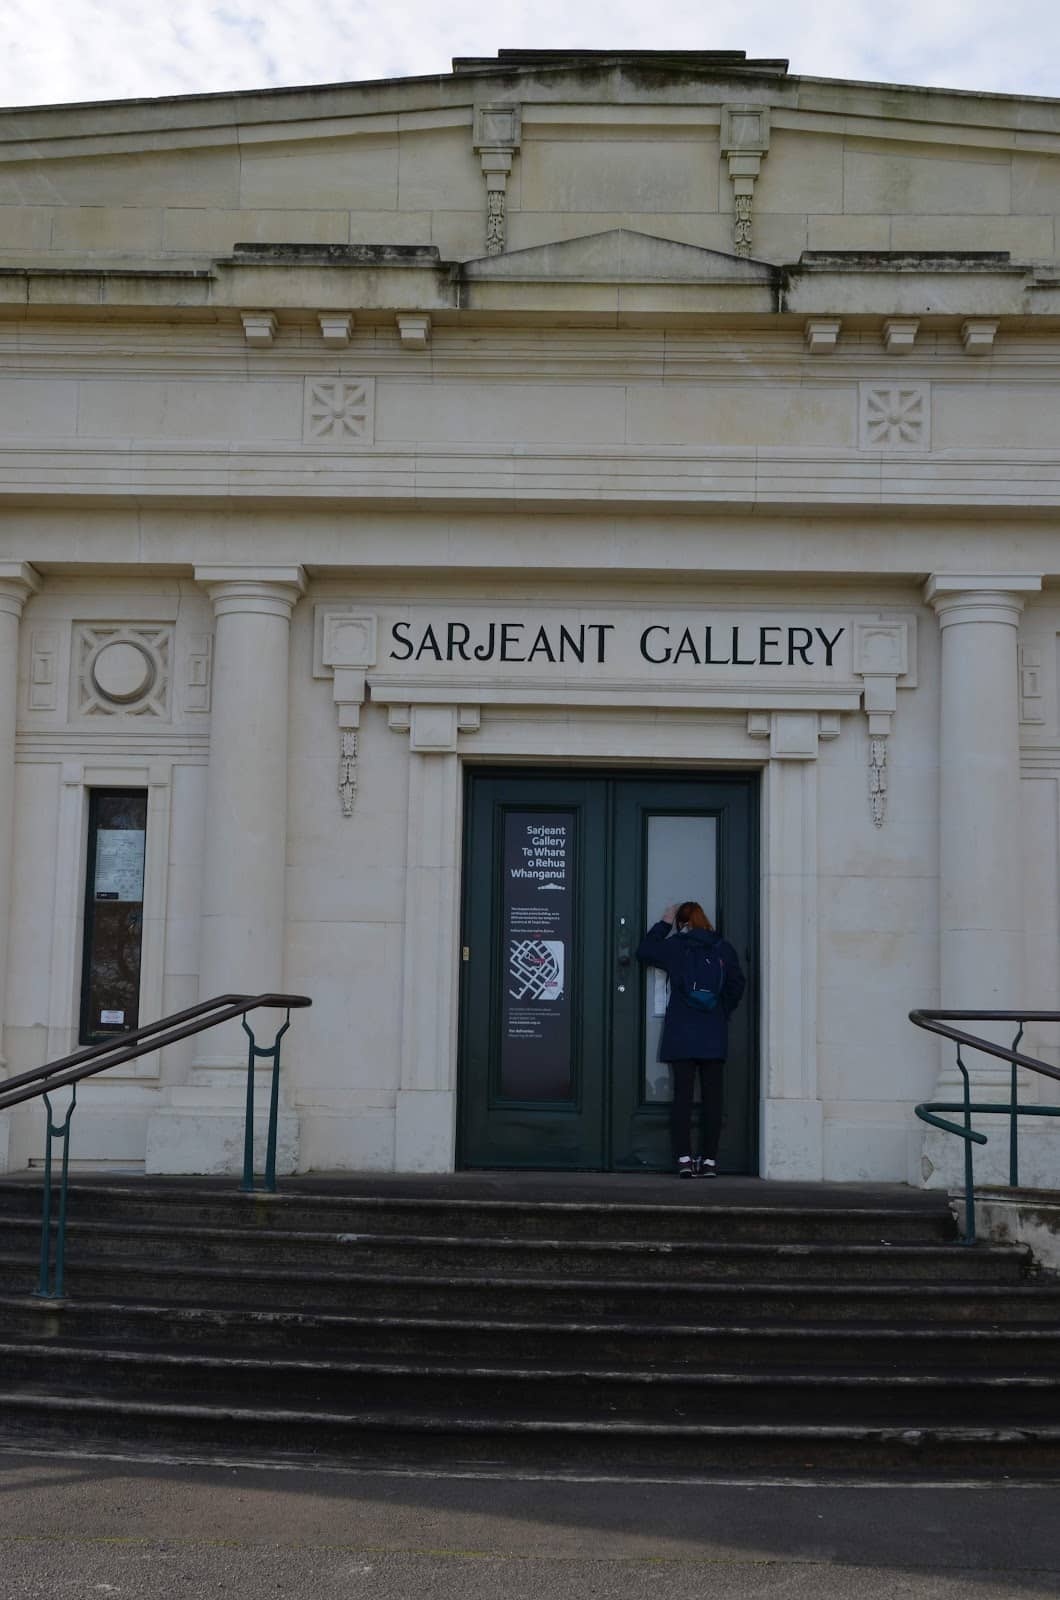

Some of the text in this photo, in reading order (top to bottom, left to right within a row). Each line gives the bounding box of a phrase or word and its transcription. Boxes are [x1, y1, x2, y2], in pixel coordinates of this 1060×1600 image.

[390, 621, 846, 666] SARJEANT GALLERY
[527, 826, 566, 836] Sarjeant
[532, 836, 566, 848] Gallery
[522, 847, 566, 856] Te Whare
[535, 858, 565, 867] Rehua
[511, 868, 565, 879] Whanganui
